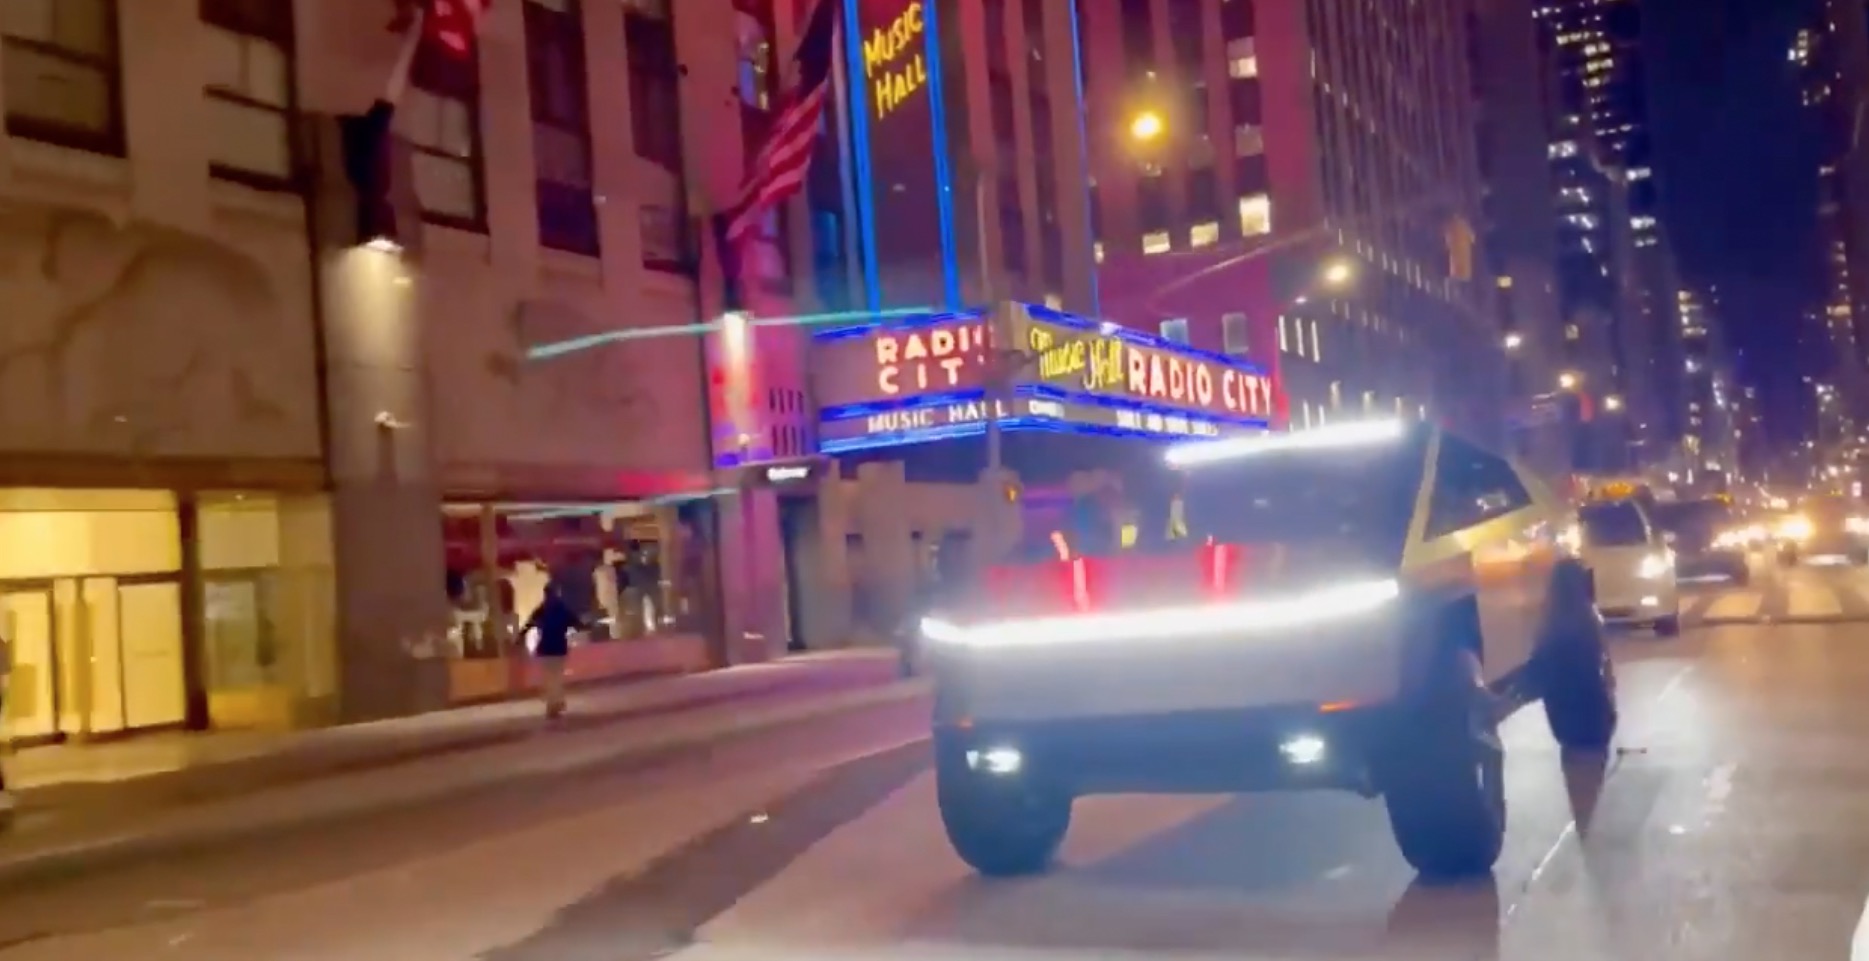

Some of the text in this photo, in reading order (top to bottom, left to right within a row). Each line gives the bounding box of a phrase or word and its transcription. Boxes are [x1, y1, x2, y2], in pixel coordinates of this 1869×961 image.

[863, 2, 923, 78] MUSIC
[876, 53, 926, 119] HALL
[1128, 349, 1271, 415] RADIO CITY
[868, 408, 935, 433] MUSIC
